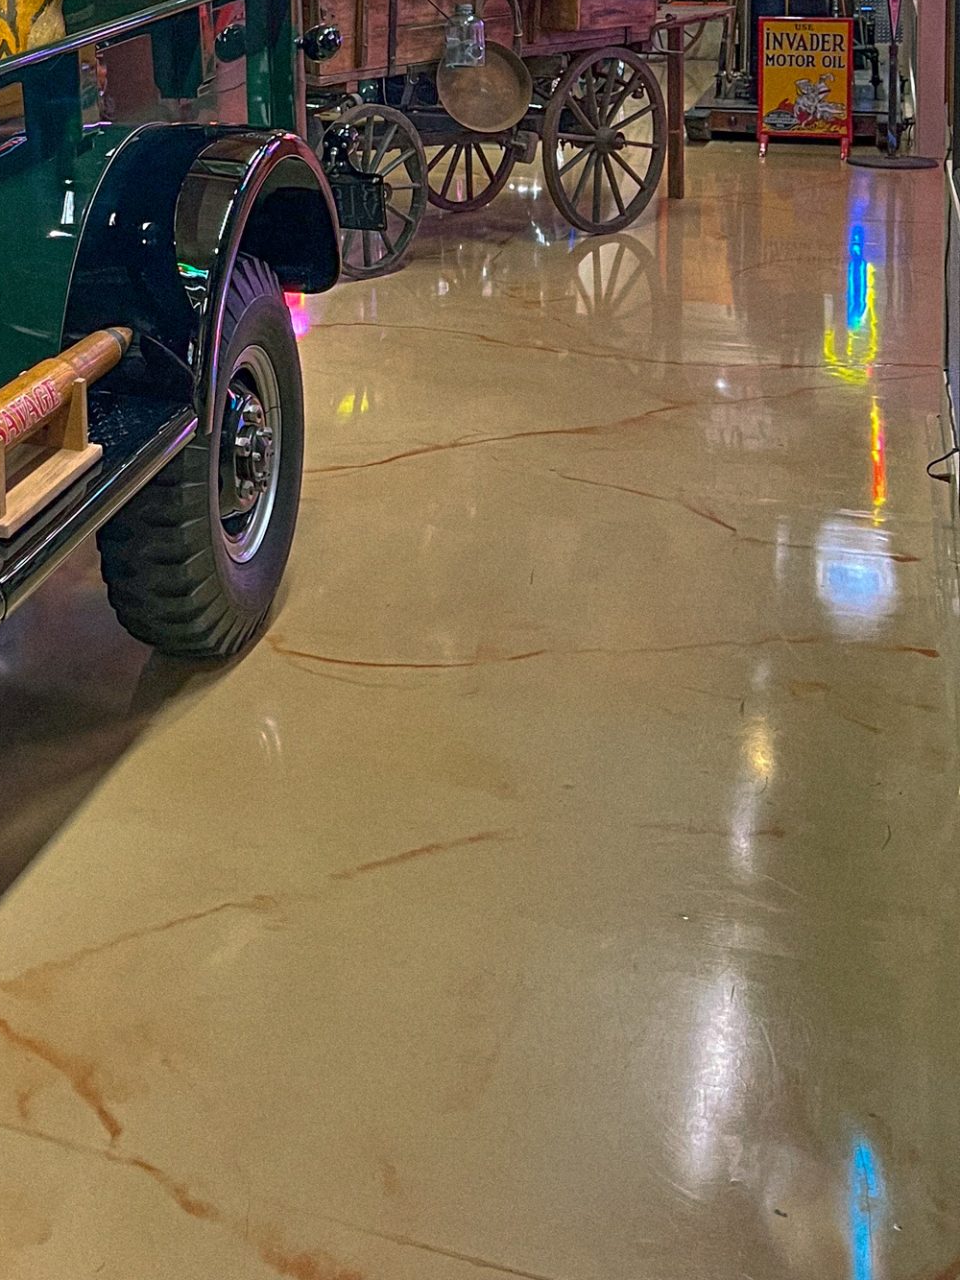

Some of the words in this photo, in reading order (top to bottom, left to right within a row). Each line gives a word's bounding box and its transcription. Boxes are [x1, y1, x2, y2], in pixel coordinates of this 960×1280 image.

[795, 23, 814, 31] USE
[765, 53, 816, 67] MOTOR
[822, 52, 846, 68] OIL
